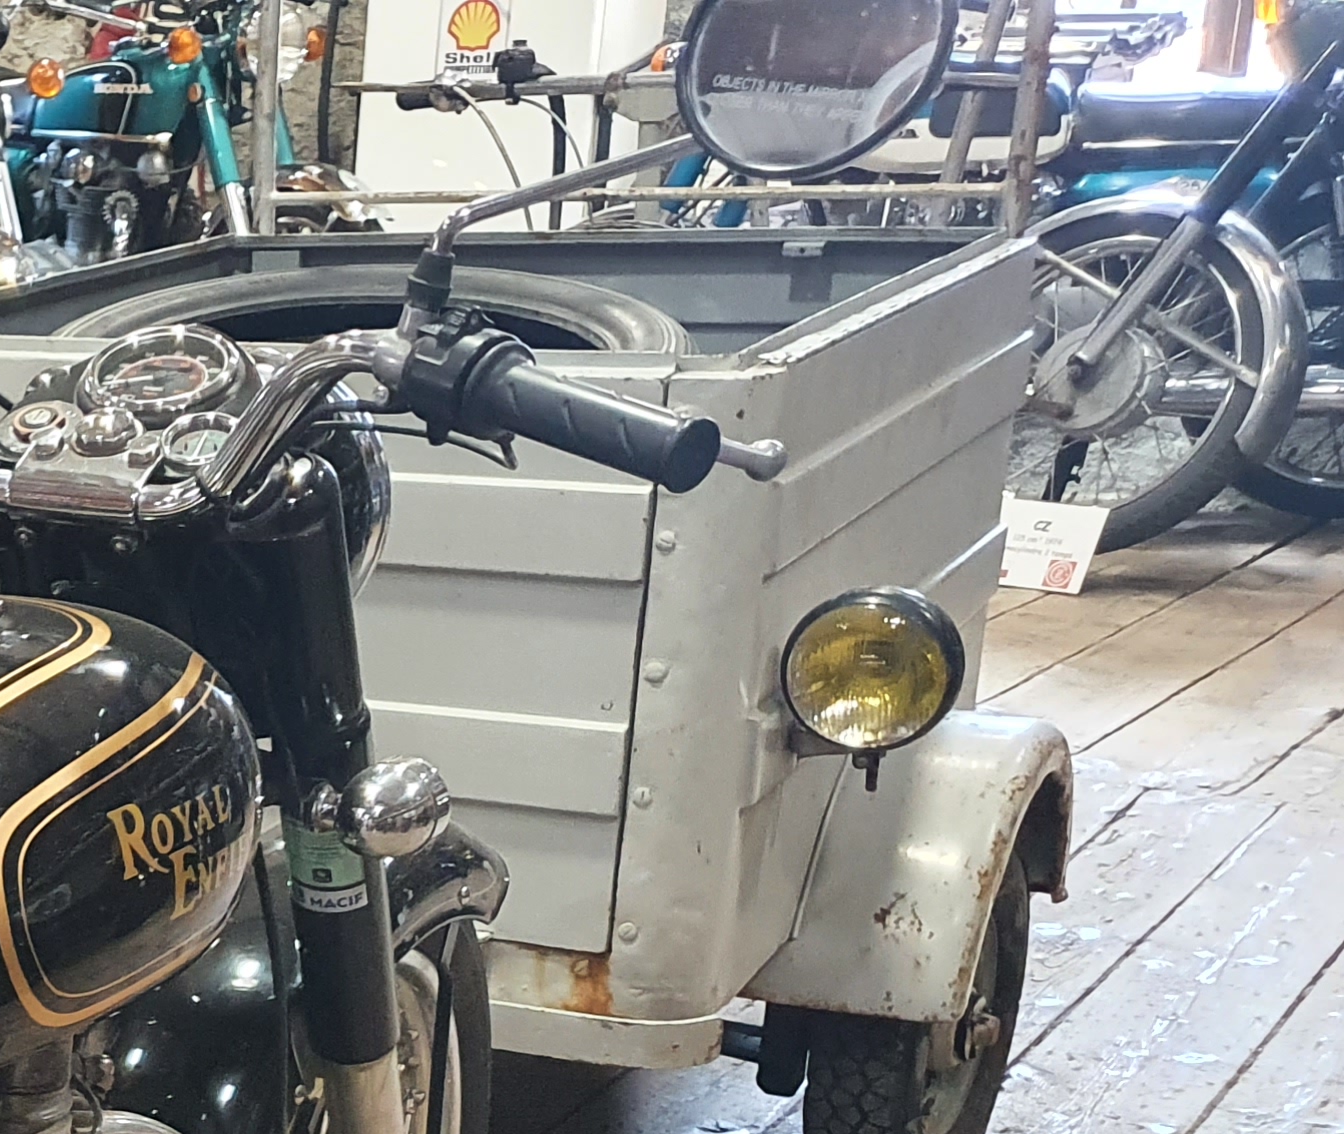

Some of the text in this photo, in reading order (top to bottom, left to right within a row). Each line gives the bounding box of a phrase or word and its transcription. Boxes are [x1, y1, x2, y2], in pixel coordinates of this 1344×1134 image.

[445, 52, 491, 64] Shel
[94, 83, 153, 94] HONDA
[712, 74, 764, 92] OBJECTS
[1033, 520, 1053, 532] CZ
[107, 784, 230, 881] ROYAL
[309, 891, 364, 908] MACIF
